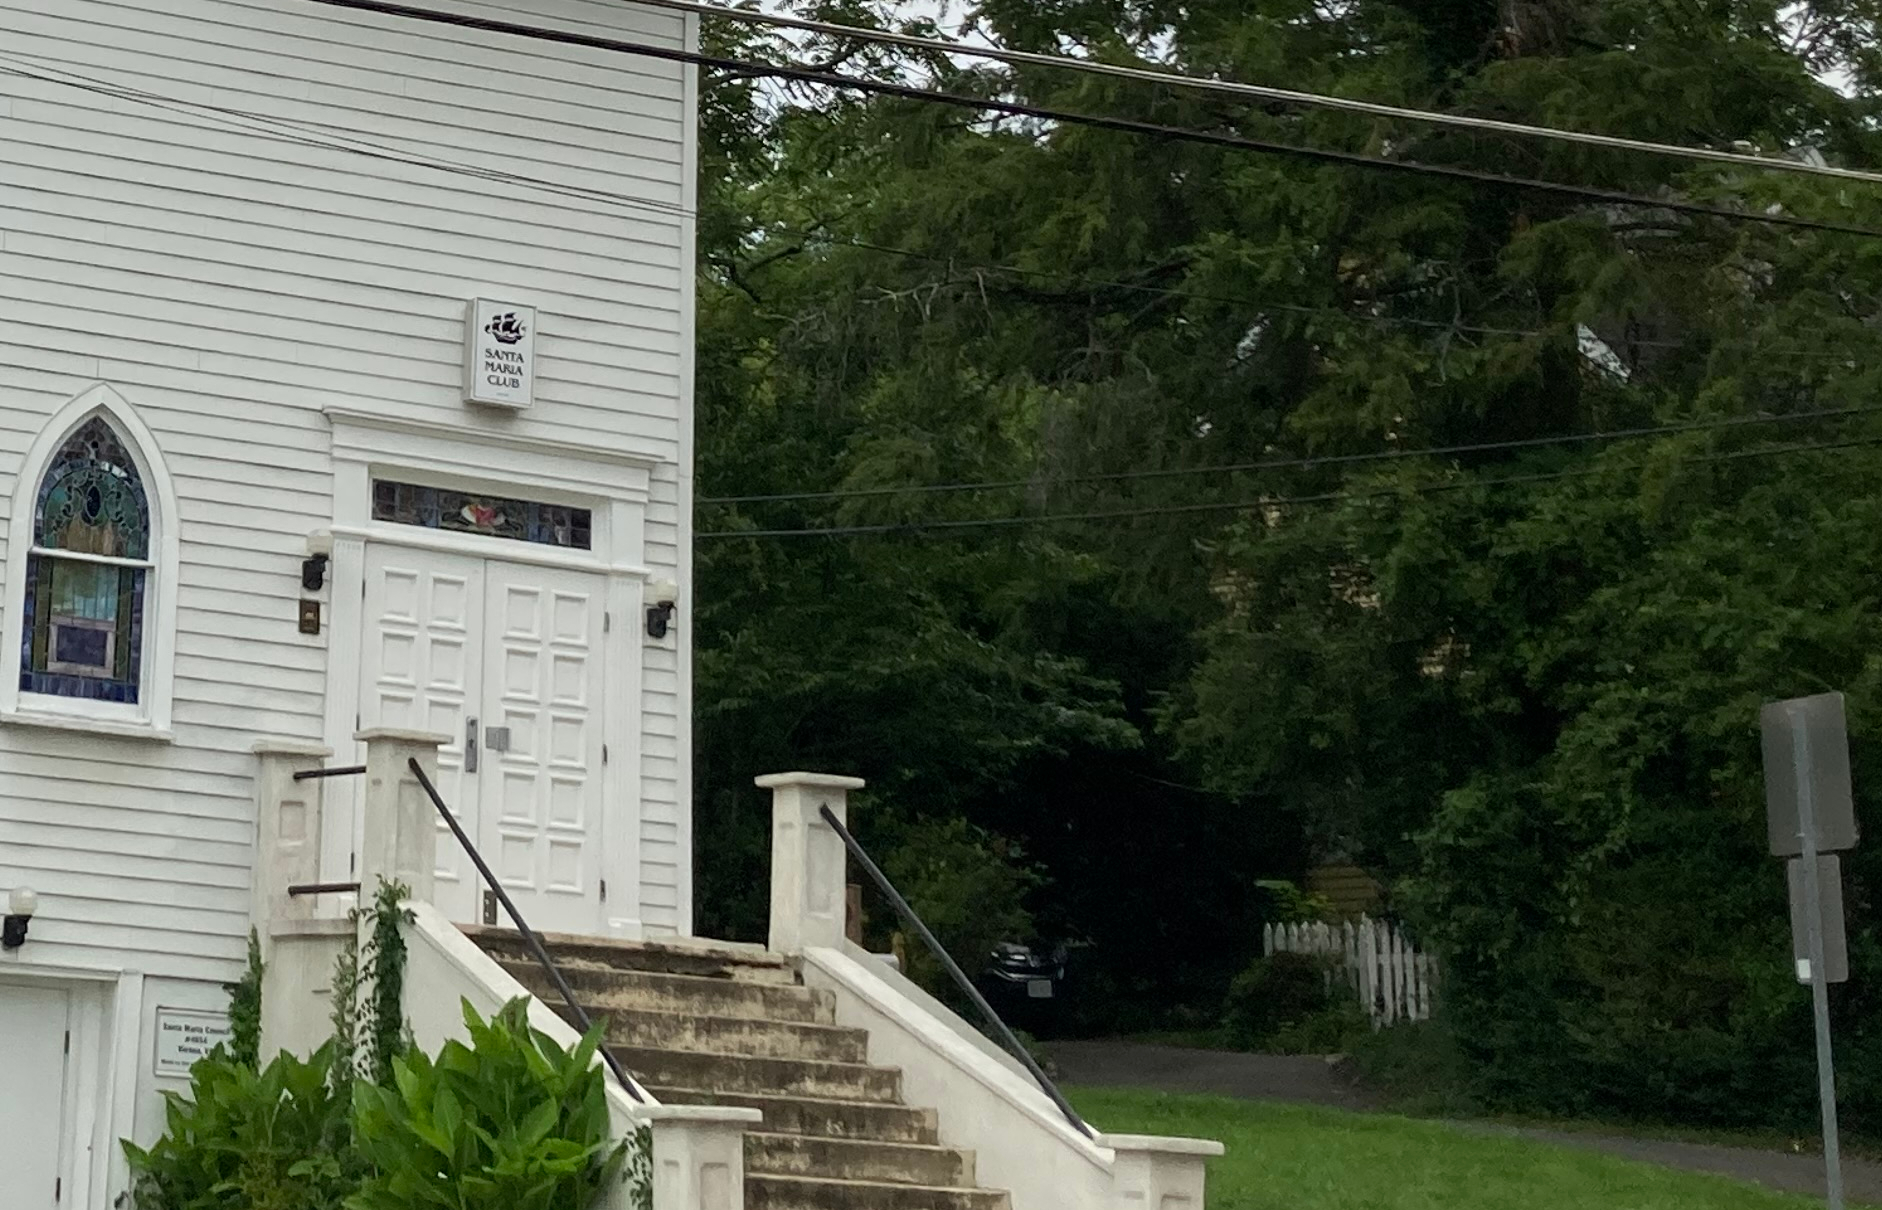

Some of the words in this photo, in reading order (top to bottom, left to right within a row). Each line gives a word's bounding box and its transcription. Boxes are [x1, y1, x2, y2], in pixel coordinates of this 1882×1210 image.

[484, 348, 525, 363] SANTA
[484, 361, 524, 376] MARIA
[487, 374, 520, 388] CLUB
